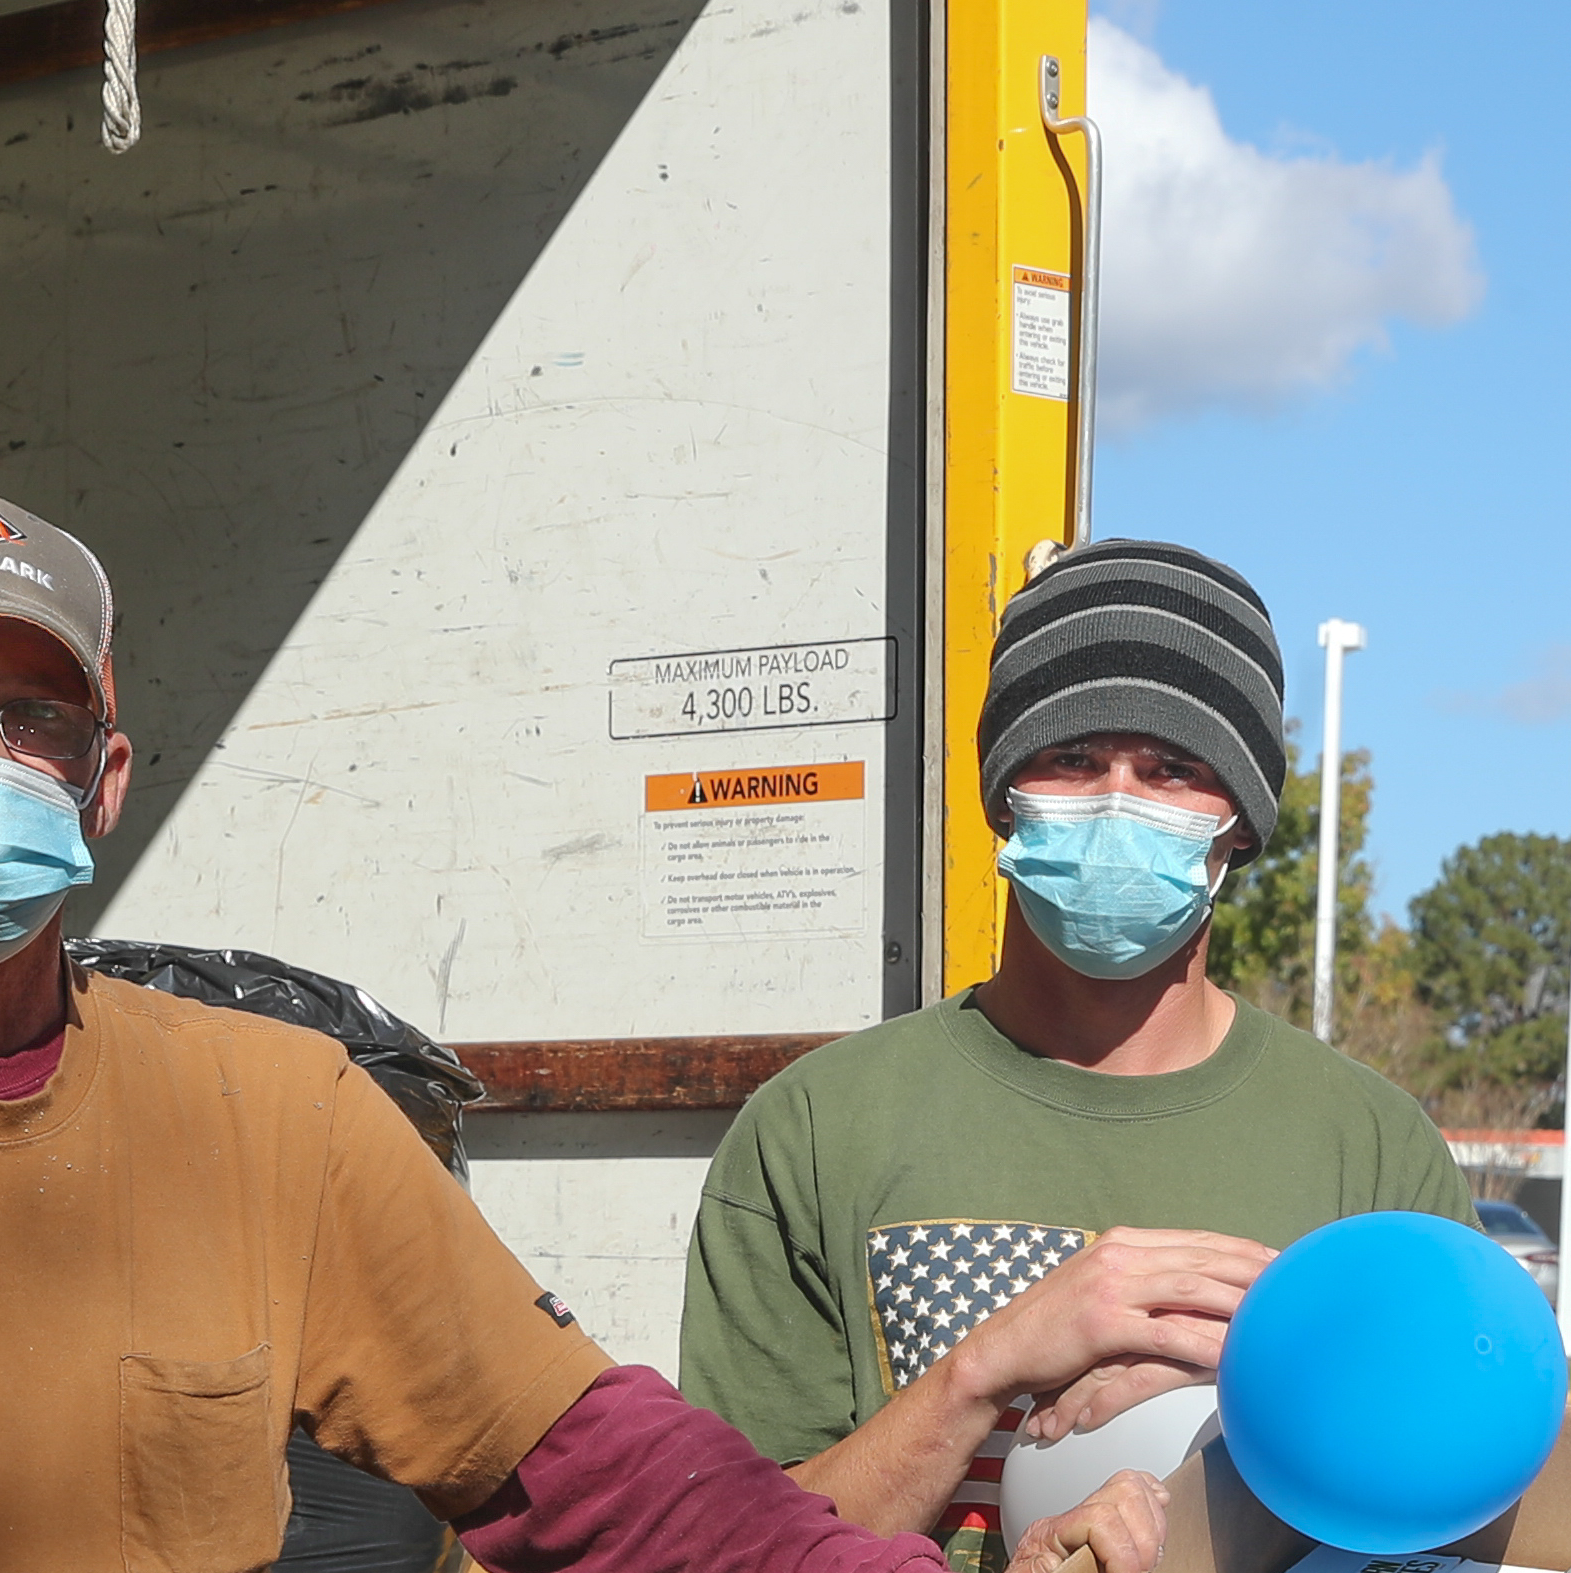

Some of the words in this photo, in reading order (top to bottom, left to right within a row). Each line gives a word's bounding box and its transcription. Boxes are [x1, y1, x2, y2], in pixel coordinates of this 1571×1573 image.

[653, 655, 752, 685] MAXIMUM
[758, 648, 849, 677] PAYLOAD
[681, 686, 753, 726] 4,300
[763, 681, 819, 716] LBS.
[709, 771, 819, 801] WARNING
[653, 821, 661, 830] To
[663, 821, 689, 831] prevent
[690, 820, 713, 828] serious
[744, 816, 774, 827] property
[668, 842, 677, 851] Do
[679, 842, 691, 850] not
[692, 840, 709, 849] allow
[711, 838, 736, 848] animals
[785, 836, 793, 844] to
[810, 834, 817, 842] in
[818, 833, 830, 842] the
[667, 853, 686, 863] cargo
[668, 874, 685, 884] Keep
[687, 872, 718, 882] overhead
[719, 871, 735, 880] door
[737, 870, 759, 879] closed
[760, 869, 778, 878] when
[780, 867, 803, 877] vehicle
[812, 867, 819, 875] in
[667, 895, 677, 905] Do
[679, 895, 691, 903] not
[692, 894, 723, 903] transport
[724, 893, 745, 902] motor
[667, 905, 700, 915] corrosives
[702, 906, 710, 914] or
[711, 904, 729, 913] other
[730, 901, 771, 912] combustible
[810, 899, 822, 908] the
[667, 918, 685, 927] cargo
